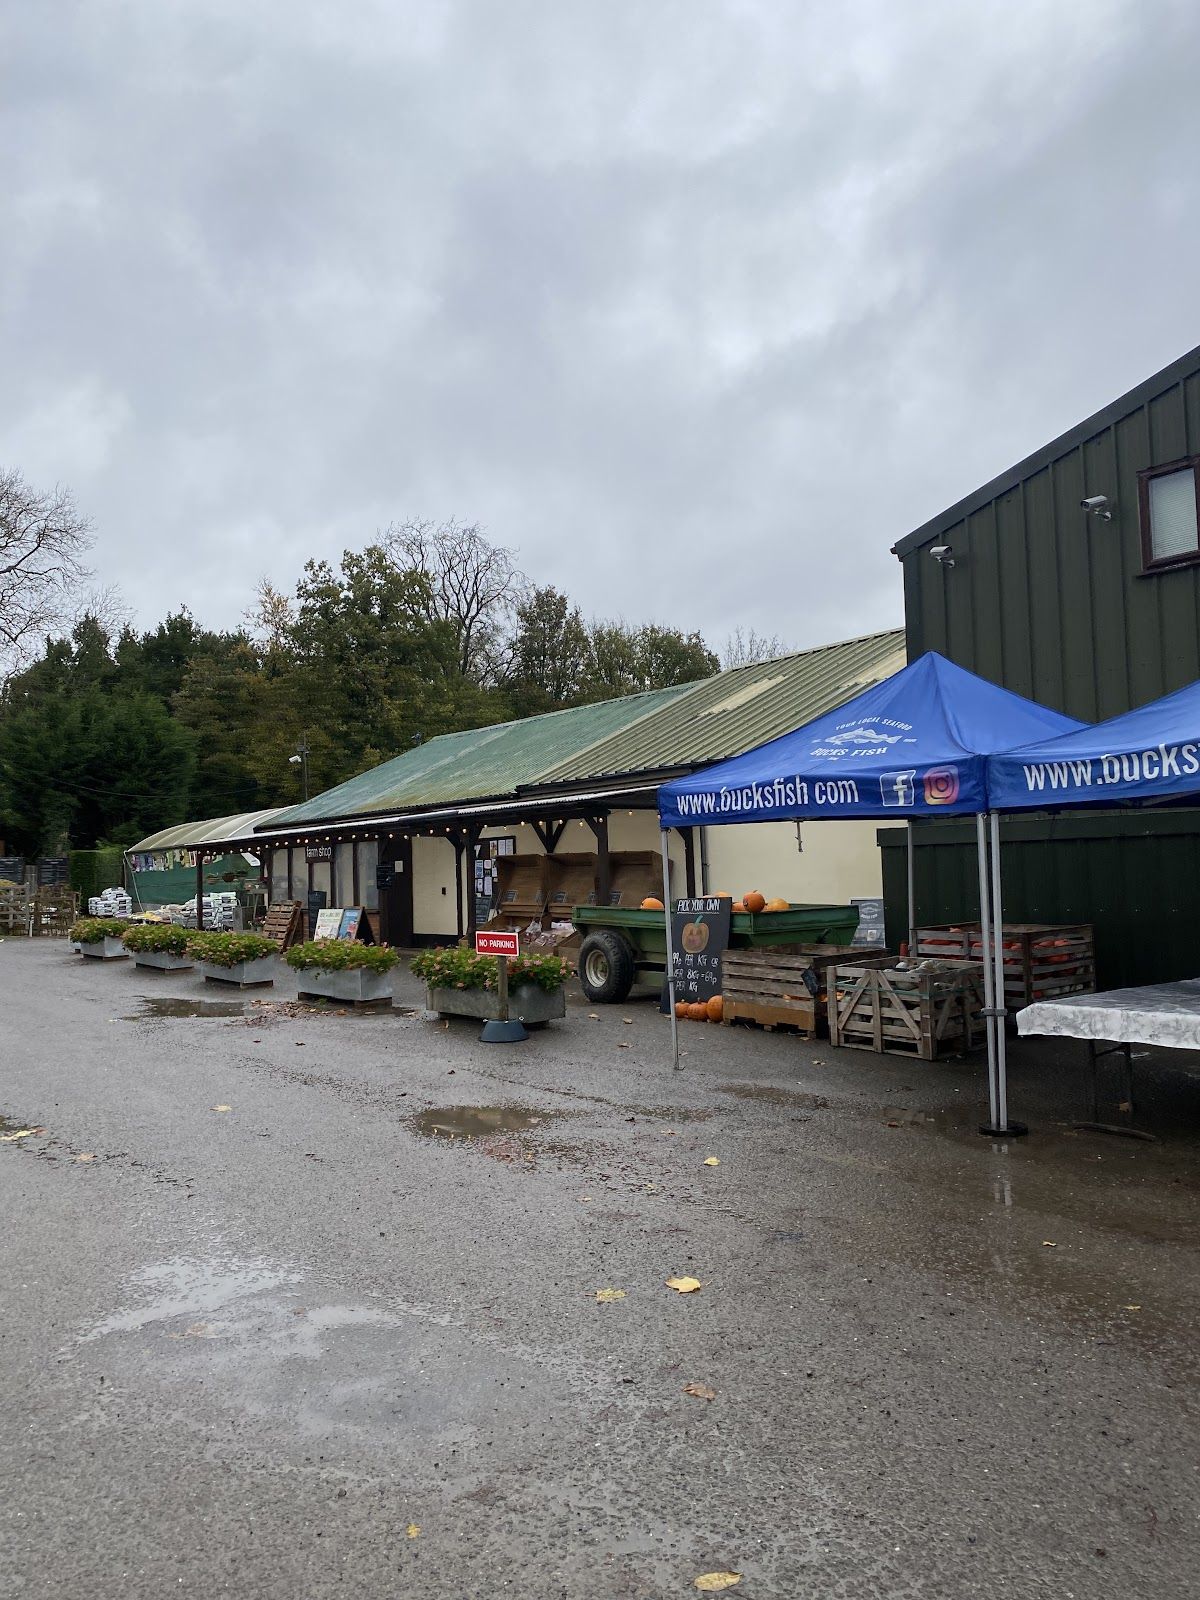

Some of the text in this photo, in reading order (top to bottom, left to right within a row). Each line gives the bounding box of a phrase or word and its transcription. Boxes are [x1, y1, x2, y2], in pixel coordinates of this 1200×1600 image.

[881, 718, 912, 731] SEAFOOD
[850, 747, 888, 757] FISH
[1023, 743, 1200, 791] www.bucks
[318, 845, 332, 859] shop
[677, 898, 720, 911] PICK YOUR OWN
[478, 939, 515, 949] NO PARKING
[697, 954, 708, 966] KG
[688, 981, 698, 992] KG
